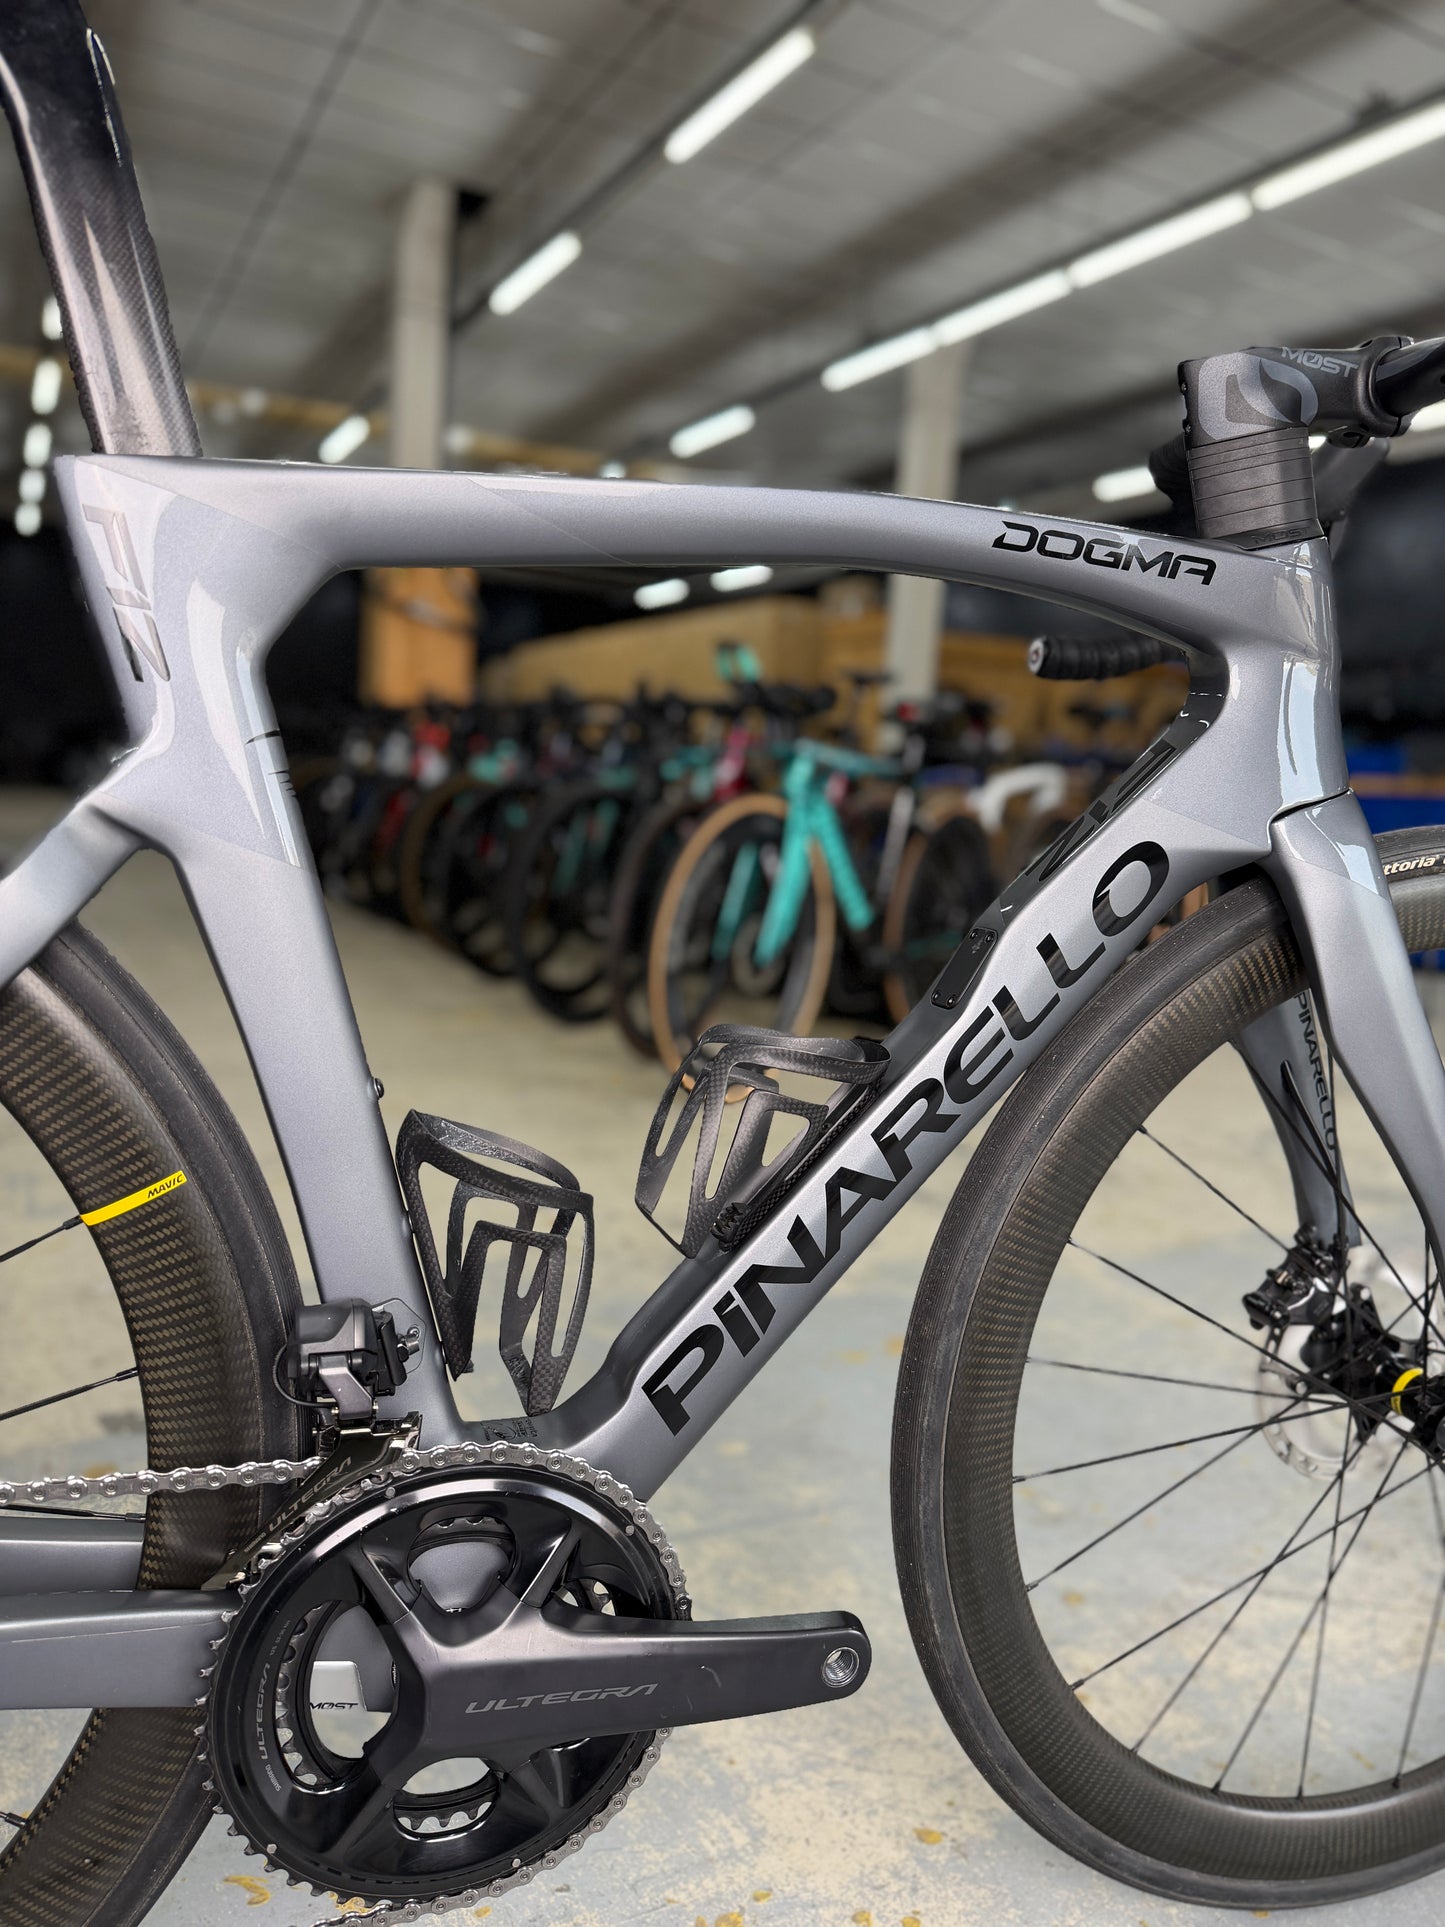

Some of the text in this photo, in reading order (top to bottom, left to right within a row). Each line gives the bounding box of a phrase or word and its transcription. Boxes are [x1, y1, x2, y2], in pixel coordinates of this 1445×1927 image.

[992, 520, 1217, 586] DOGMA
[1383, 855, 1437, 876] ttoria
[1294, 991, 1337, 1151] PINARELLO
[641, 841, 1170, 1436] PINARELLO
[147, 1174, 183, 1199] MAVIC
[269, 1456, 352, 1532] ULTEGRA
[256, 1662, 271, 1760] ULTEGRA
[465, 1683, 659, 1714] ULTEGRA
